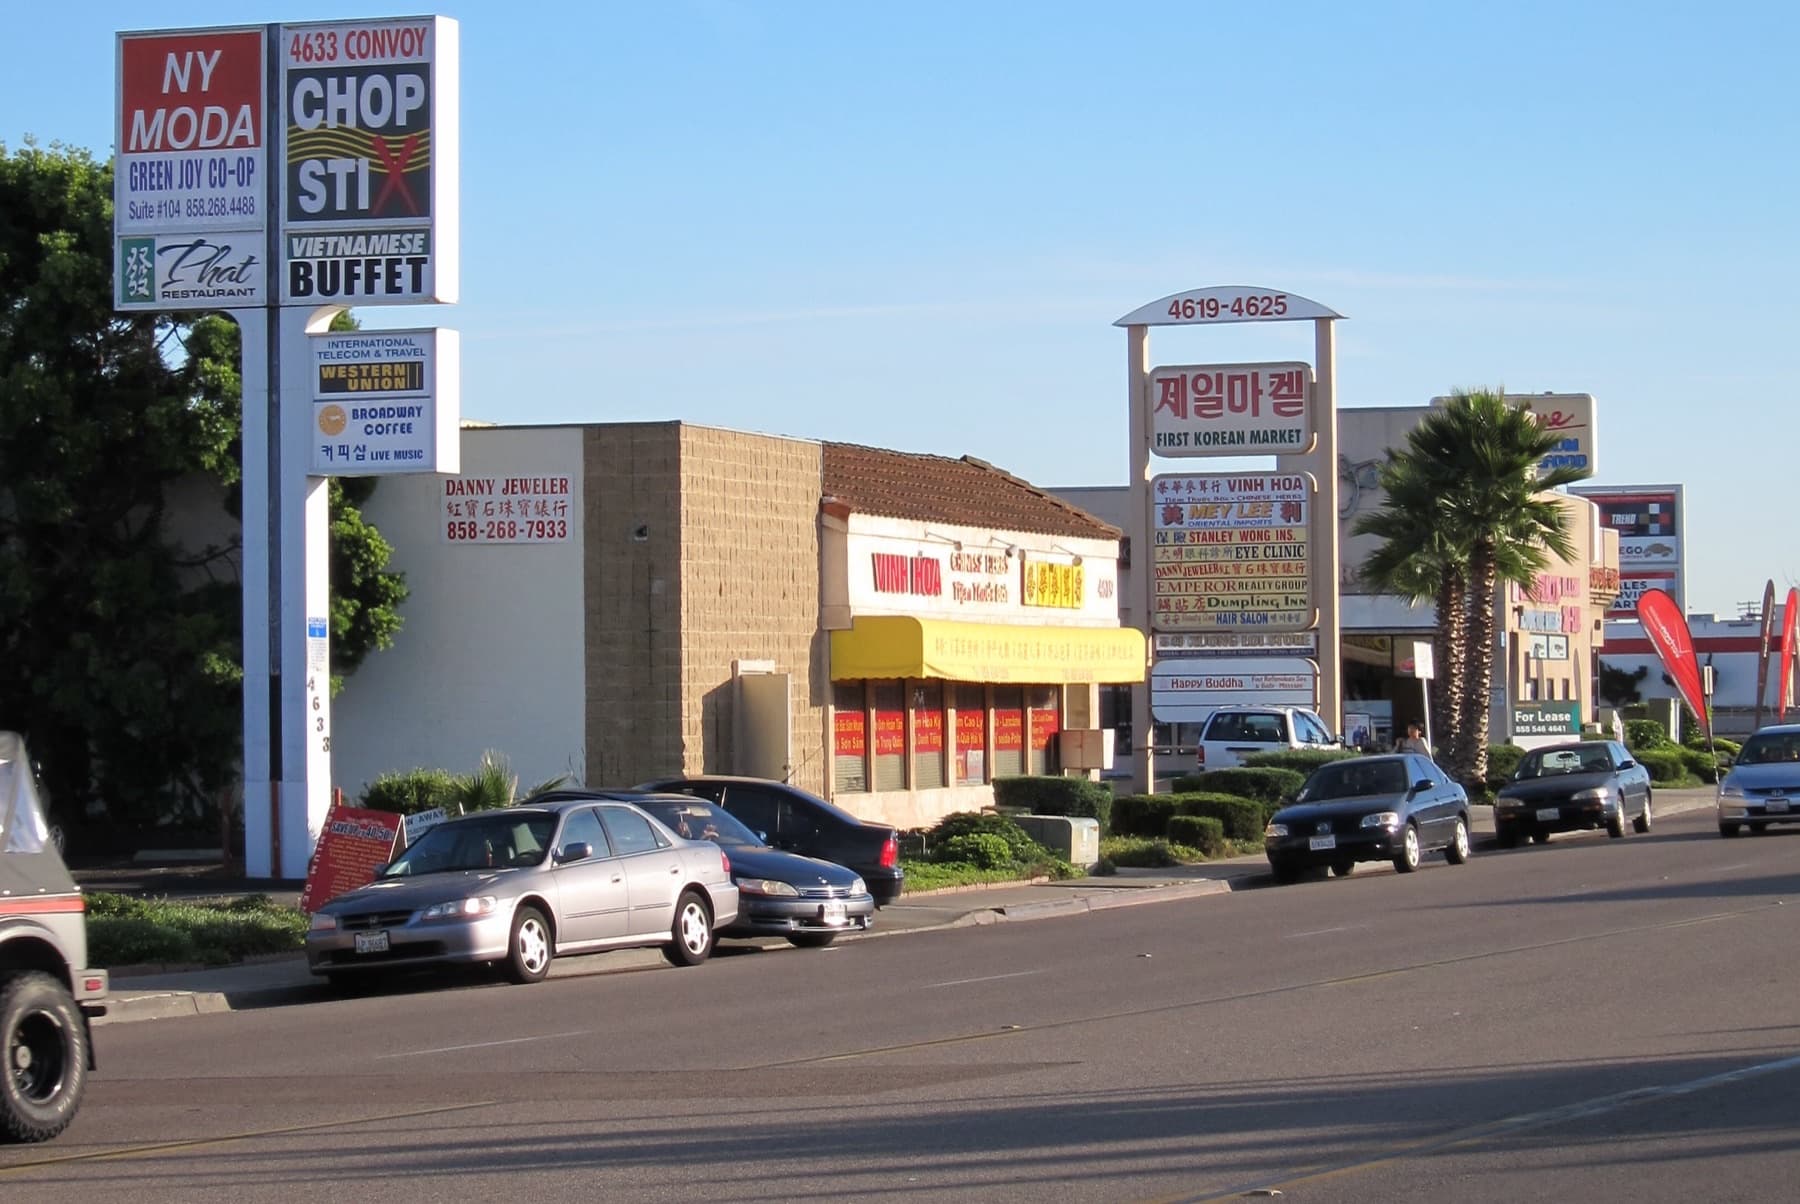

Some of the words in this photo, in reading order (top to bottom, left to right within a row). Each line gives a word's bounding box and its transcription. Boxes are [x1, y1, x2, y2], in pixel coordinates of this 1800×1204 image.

[290, 33, 338, 63] 4633
[345, 27, 428, 60] CONVOY
[161, 50, 222, 95] NY
[292, 73, 426, 131] CHOP
[128, 104, 256, 151] MODA
[129, 159, 173, 192] GREEN
[177, 158, 203, 190] JOY
[208, 156, 256, 188] CO-OP
[128, 199, 155, 220] Suite
[157, 199, 181, 219] #104
[185, 195, 256, 218] 858.268.4488
[290, 233, 425, 258] VIETNAMESE
[157, 239, 261, 290] Phat
[289, 257, 428, 298] BUFFET
[161, 288, 257, 300] RESTAURANT
[1167, 295, 1288, 319] 4619-4625
[327, 338, 415, 350] INTERNATIONAL
[317, 349, 371, 360] TELECOM
[374, 350, 382, 359] &
[385, 347, 426, 358] TRAVEL
[321, 363, 407, 379] WESTERN
[348, 377, 407, 391] UNION
[351, 406, 423, 421] BROADWAY
[364, 422, 413, 436] COFFEE
[1156, 432, 1189, 447] FIRST
[1194, 431, 1245, 446] KOREAN
[1250, 429, 1302, 444] MARKET
[370, 450, 390, 462] LIVE
[394, 449, 424, 461] MUSIC
[445, 479, 496, 496] DANNY
[501, 477, 569, 496] JEWELER
[1227, 478, 1264, 492] VINH
[1270, 477, 1303, 491] HOA
[1188, 504, 1234, 519] MEY
[1237, 502, 1274, 518] LEE
[447, 520, 568, 540] 858-268-7933
[1188, 520, 1230, 528] ORIENTAL
[1189, 530, 1233, 543] STANLEY
[1239, 529, 1271, 542] WONG
[1275, 529, 1297, 541] INS.
[1235, 546, 1259, 559] EYE
[1263, 545, 1305, 558] CLINIC
[1619, 546, 1643, 555] EGO
[871, 553, 908, 593] VINH
[910, 556, 942, 595] HOA
[1156, 562, 1183, 577] DANNY
[1156, 580, 1236, 593] EMPEROR
[1238, 580, 1272, 590] REALTY
[1275, 580, 1308, 589] GROUP
[1216, 613, 1237, 625] HAIR
[1240, 612, 1268, 624] SALON
[1171, 678, 1202, 689] Happy
[1205, 677, 1243, 689] Buddha
[1515, 711, 1535, 722] For
[1538, 710, 1571, 722] Lease
[418, 810, 443, 822] AWAY
